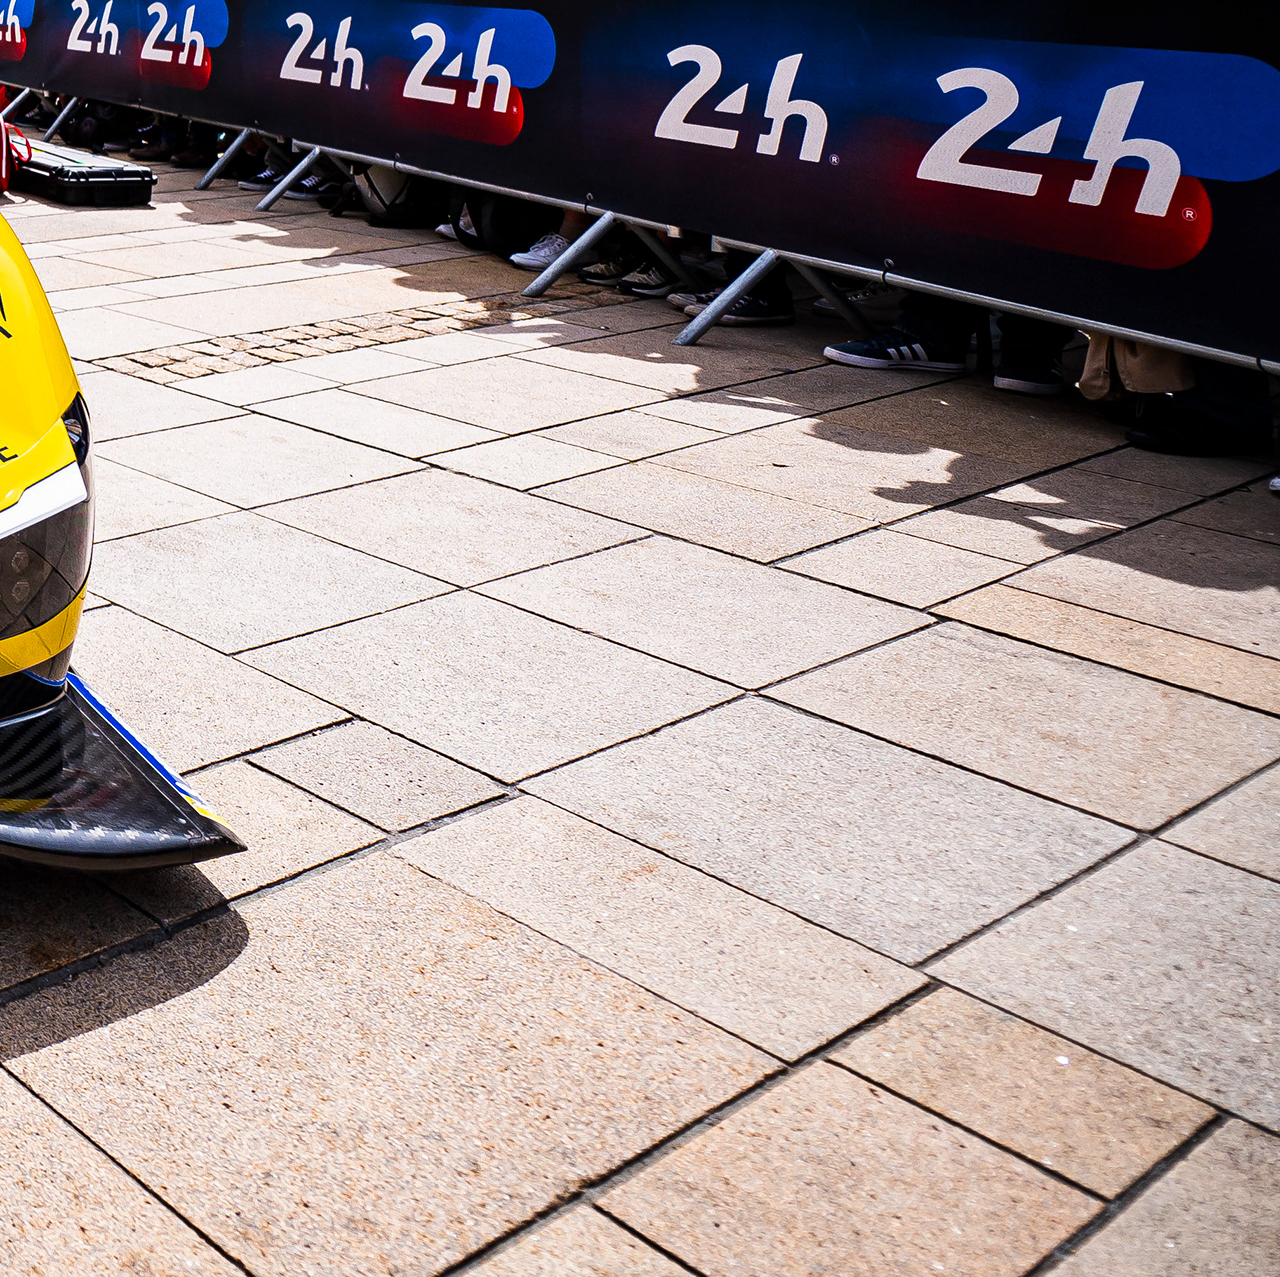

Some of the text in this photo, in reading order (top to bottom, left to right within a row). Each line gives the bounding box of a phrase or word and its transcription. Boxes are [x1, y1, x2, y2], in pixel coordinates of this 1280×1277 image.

[140, 1, 205, 67] 24h
[279, 12, 364, 90] 24h
[402, 22, 511, 113] 24h
[654, 44, 1182, 217] 24h 24h
